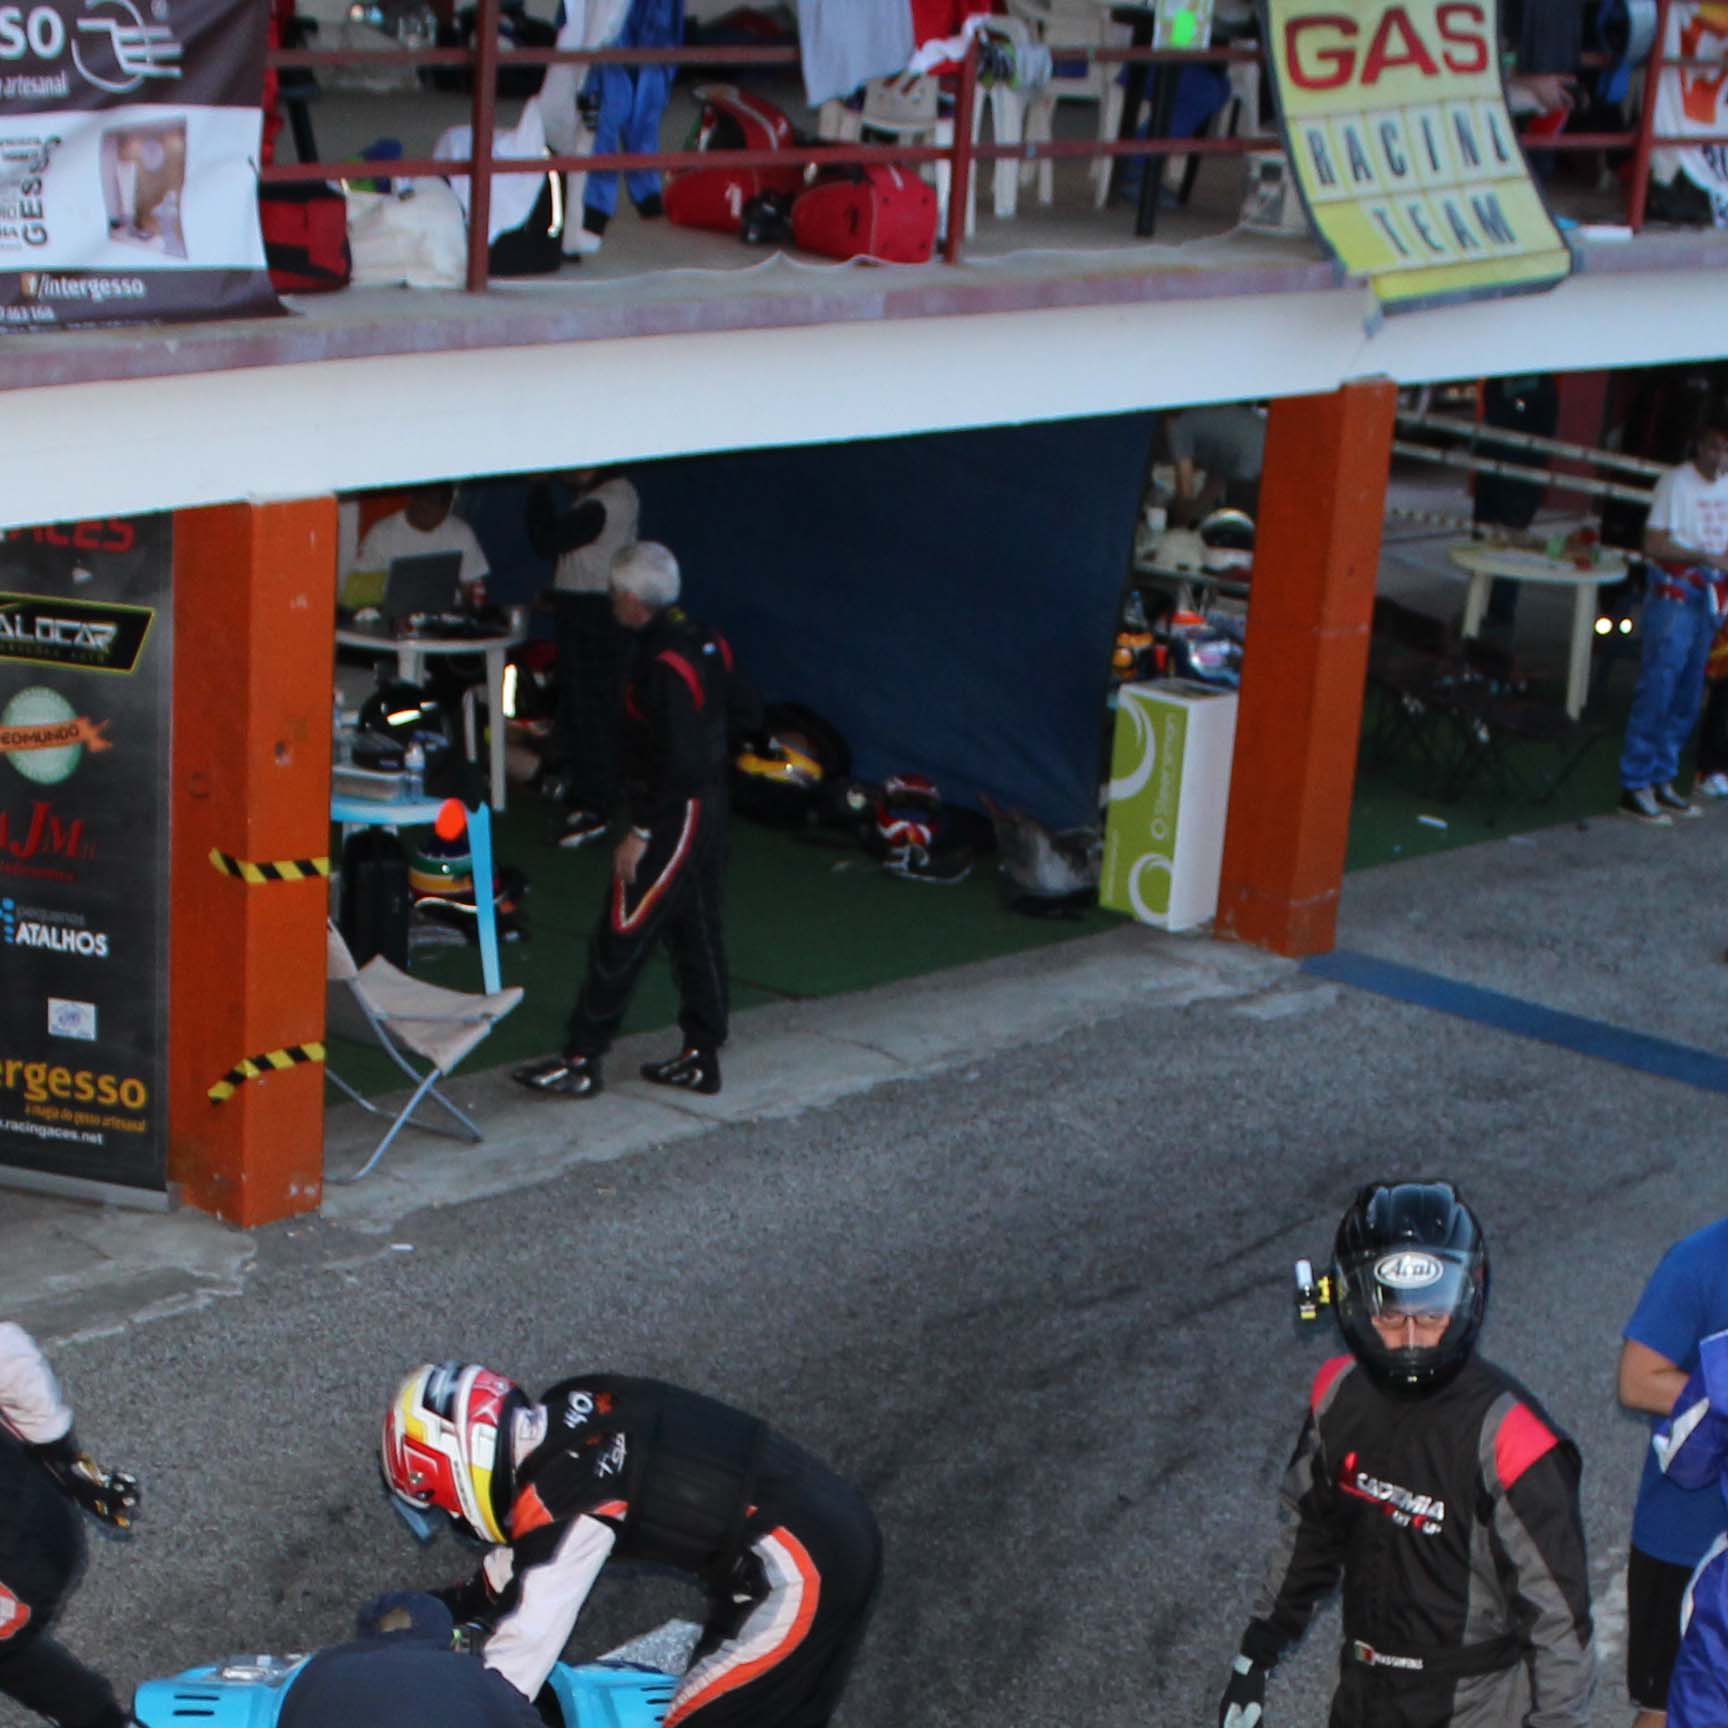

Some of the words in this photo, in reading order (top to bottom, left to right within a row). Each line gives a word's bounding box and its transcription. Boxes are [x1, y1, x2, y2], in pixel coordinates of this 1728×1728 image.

[1283, 2, 1490, 93] GAS
[1372, 193, 1517, 259] TEAM
[14, 921, 110, 958] ATALHOS
